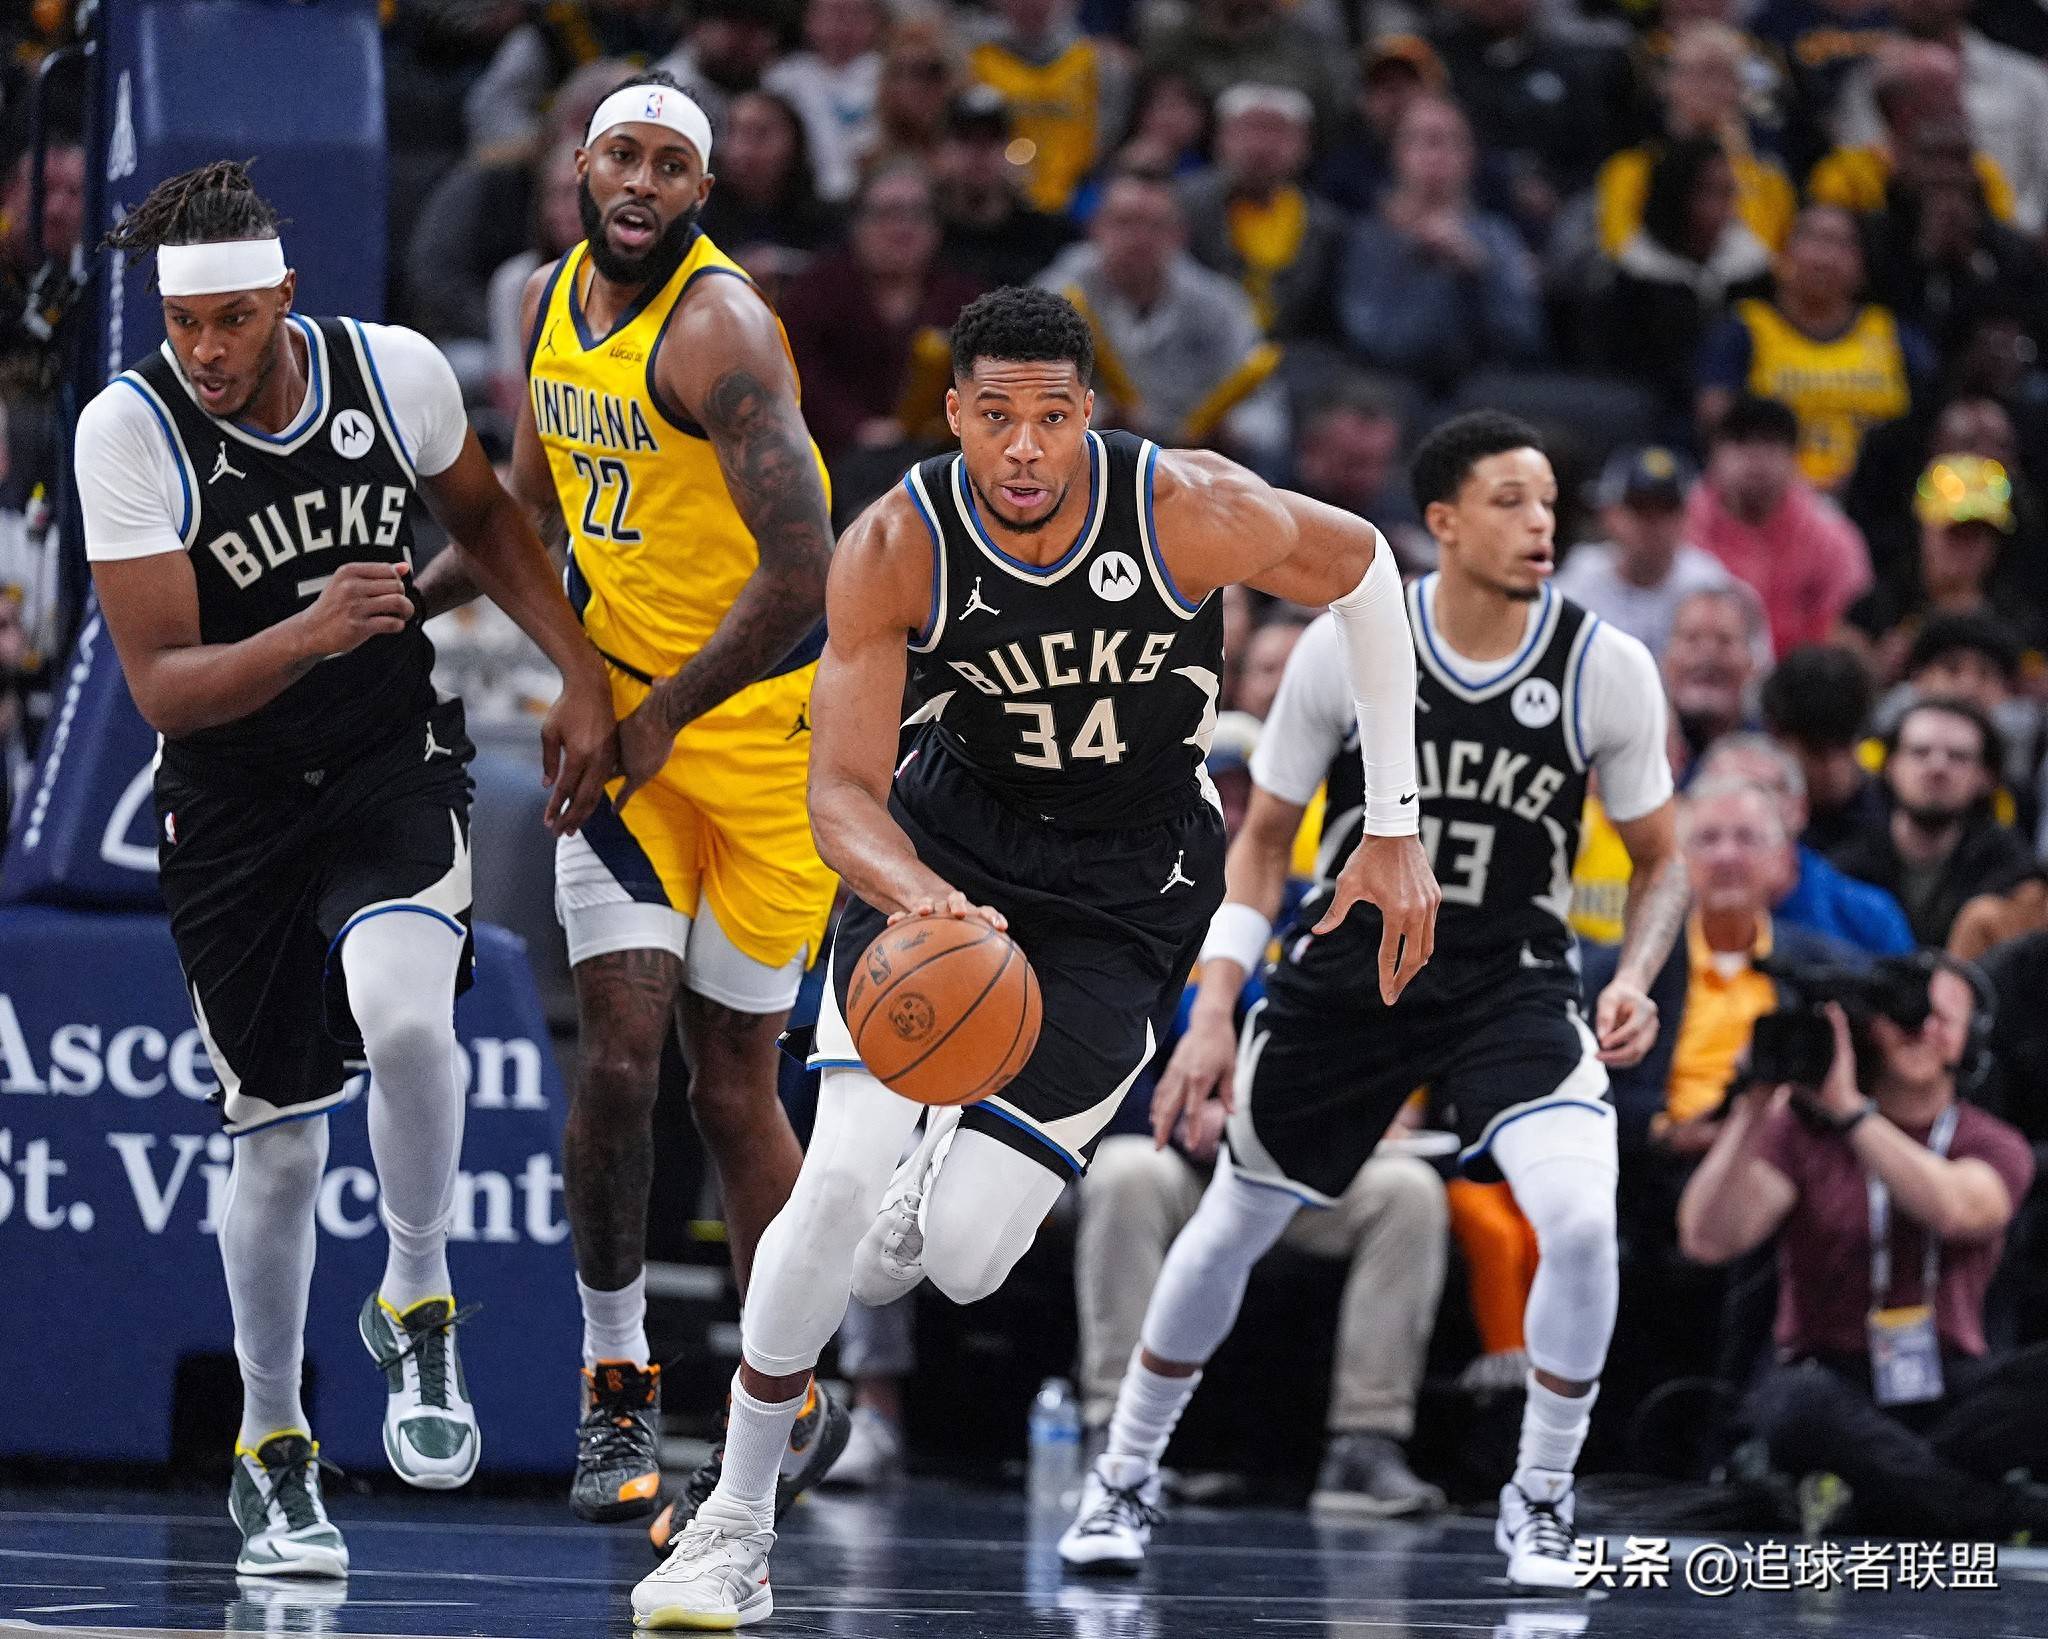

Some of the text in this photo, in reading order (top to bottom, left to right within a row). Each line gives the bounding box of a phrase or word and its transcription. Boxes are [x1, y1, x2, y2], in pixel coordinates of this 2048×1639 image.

[534, 378, 659, 451] INDIANA
[571, 450, 643, 543] 22
[208, 484, 407, 591] BUCKS
[946, 628, 1178, 696] BUCKS
[1003, 697, 1128, 771] 34
[1414, 739, 1567, 823] UCKS
